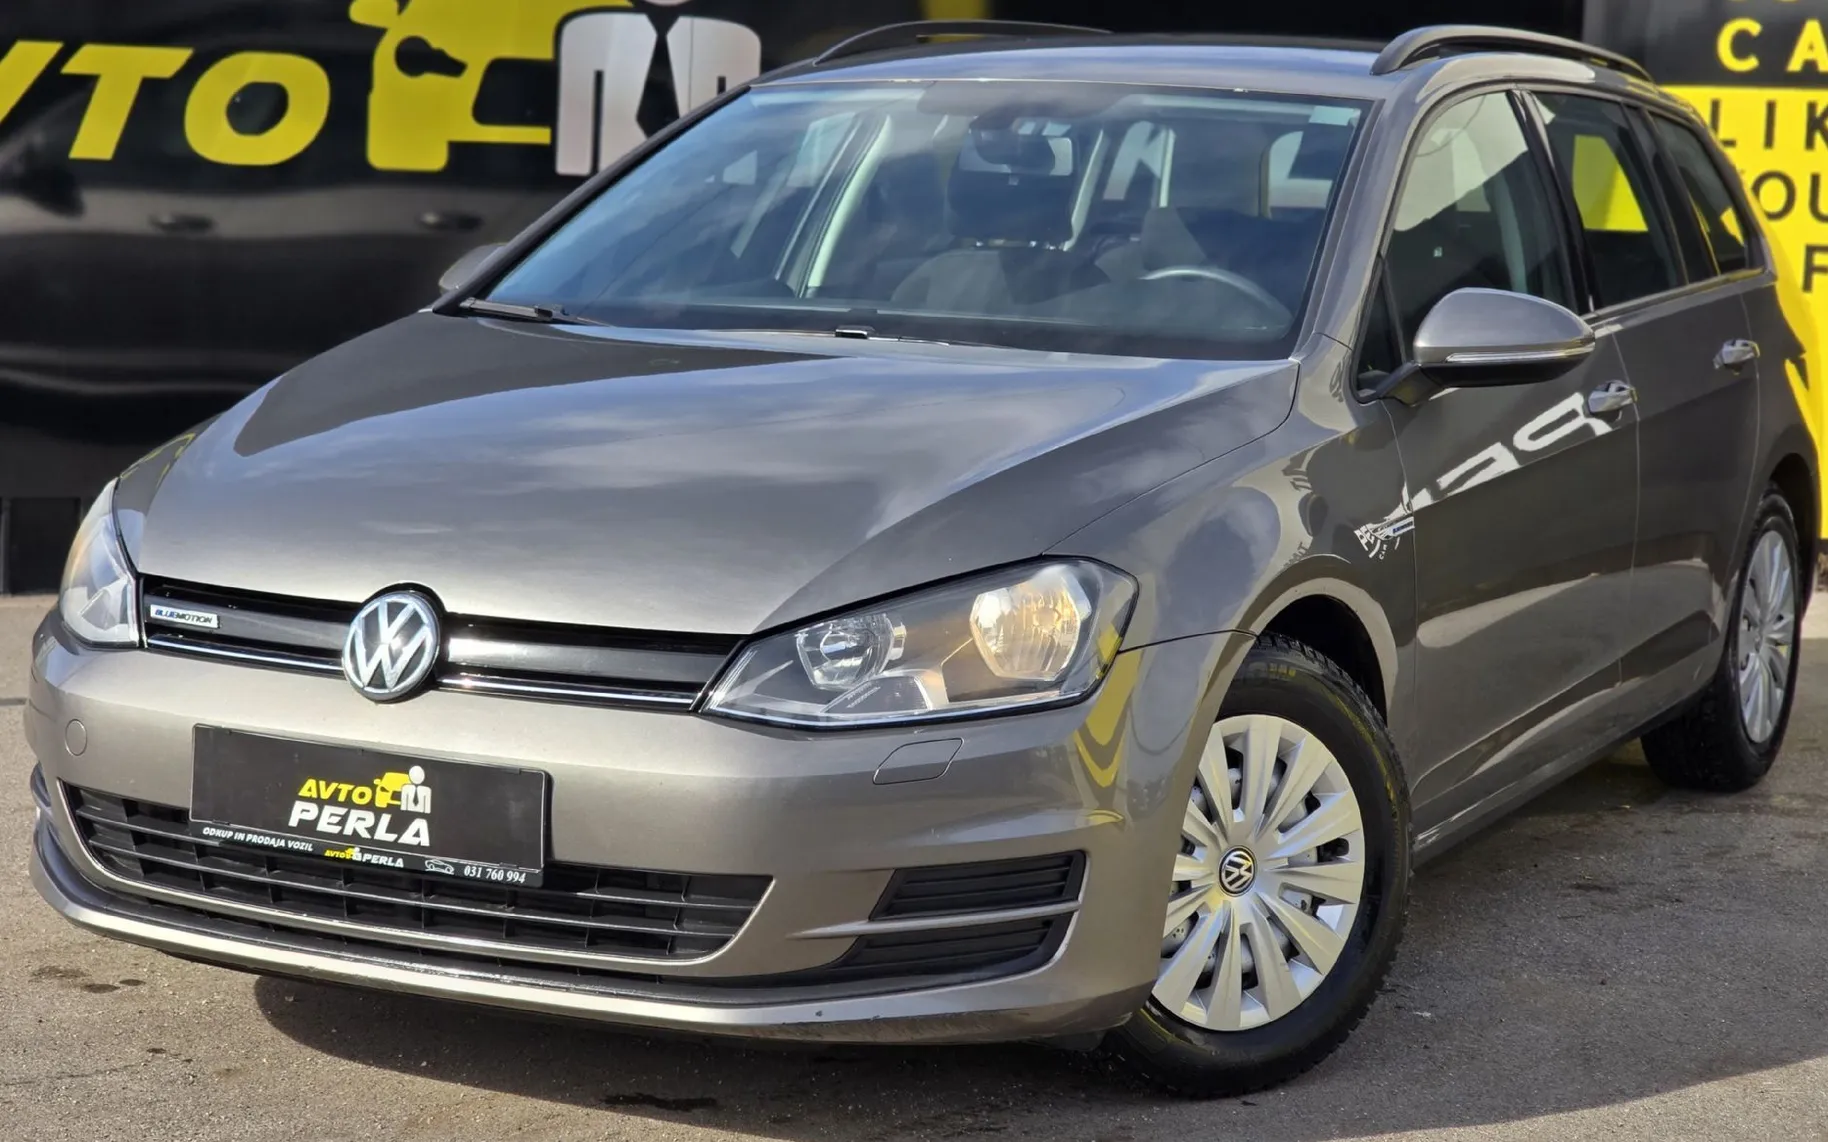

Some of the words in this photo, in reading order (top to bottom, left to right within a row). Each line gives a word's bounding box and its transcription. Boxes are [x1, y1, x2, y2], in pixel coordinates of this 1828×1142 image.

[154, 608, 213, 624] BLUEMOTION
[298, 778, 372, 805] AVTO
[288, 800, 430, 847] PERLA
[202, 826, 233, 839] ODKUP
[234, 831, 245, 841] IN
[245, 833, 286, 848] PRODAJA
[287, 839, 314, 852] VOZIL
[324, 849, 347, 859] AVTO
[361, 854, 404, 868] PERLA
[463, 865, 482, 878] 031
[485, 867, 504, 881] 760
[506, 870, 526, 884] 994
